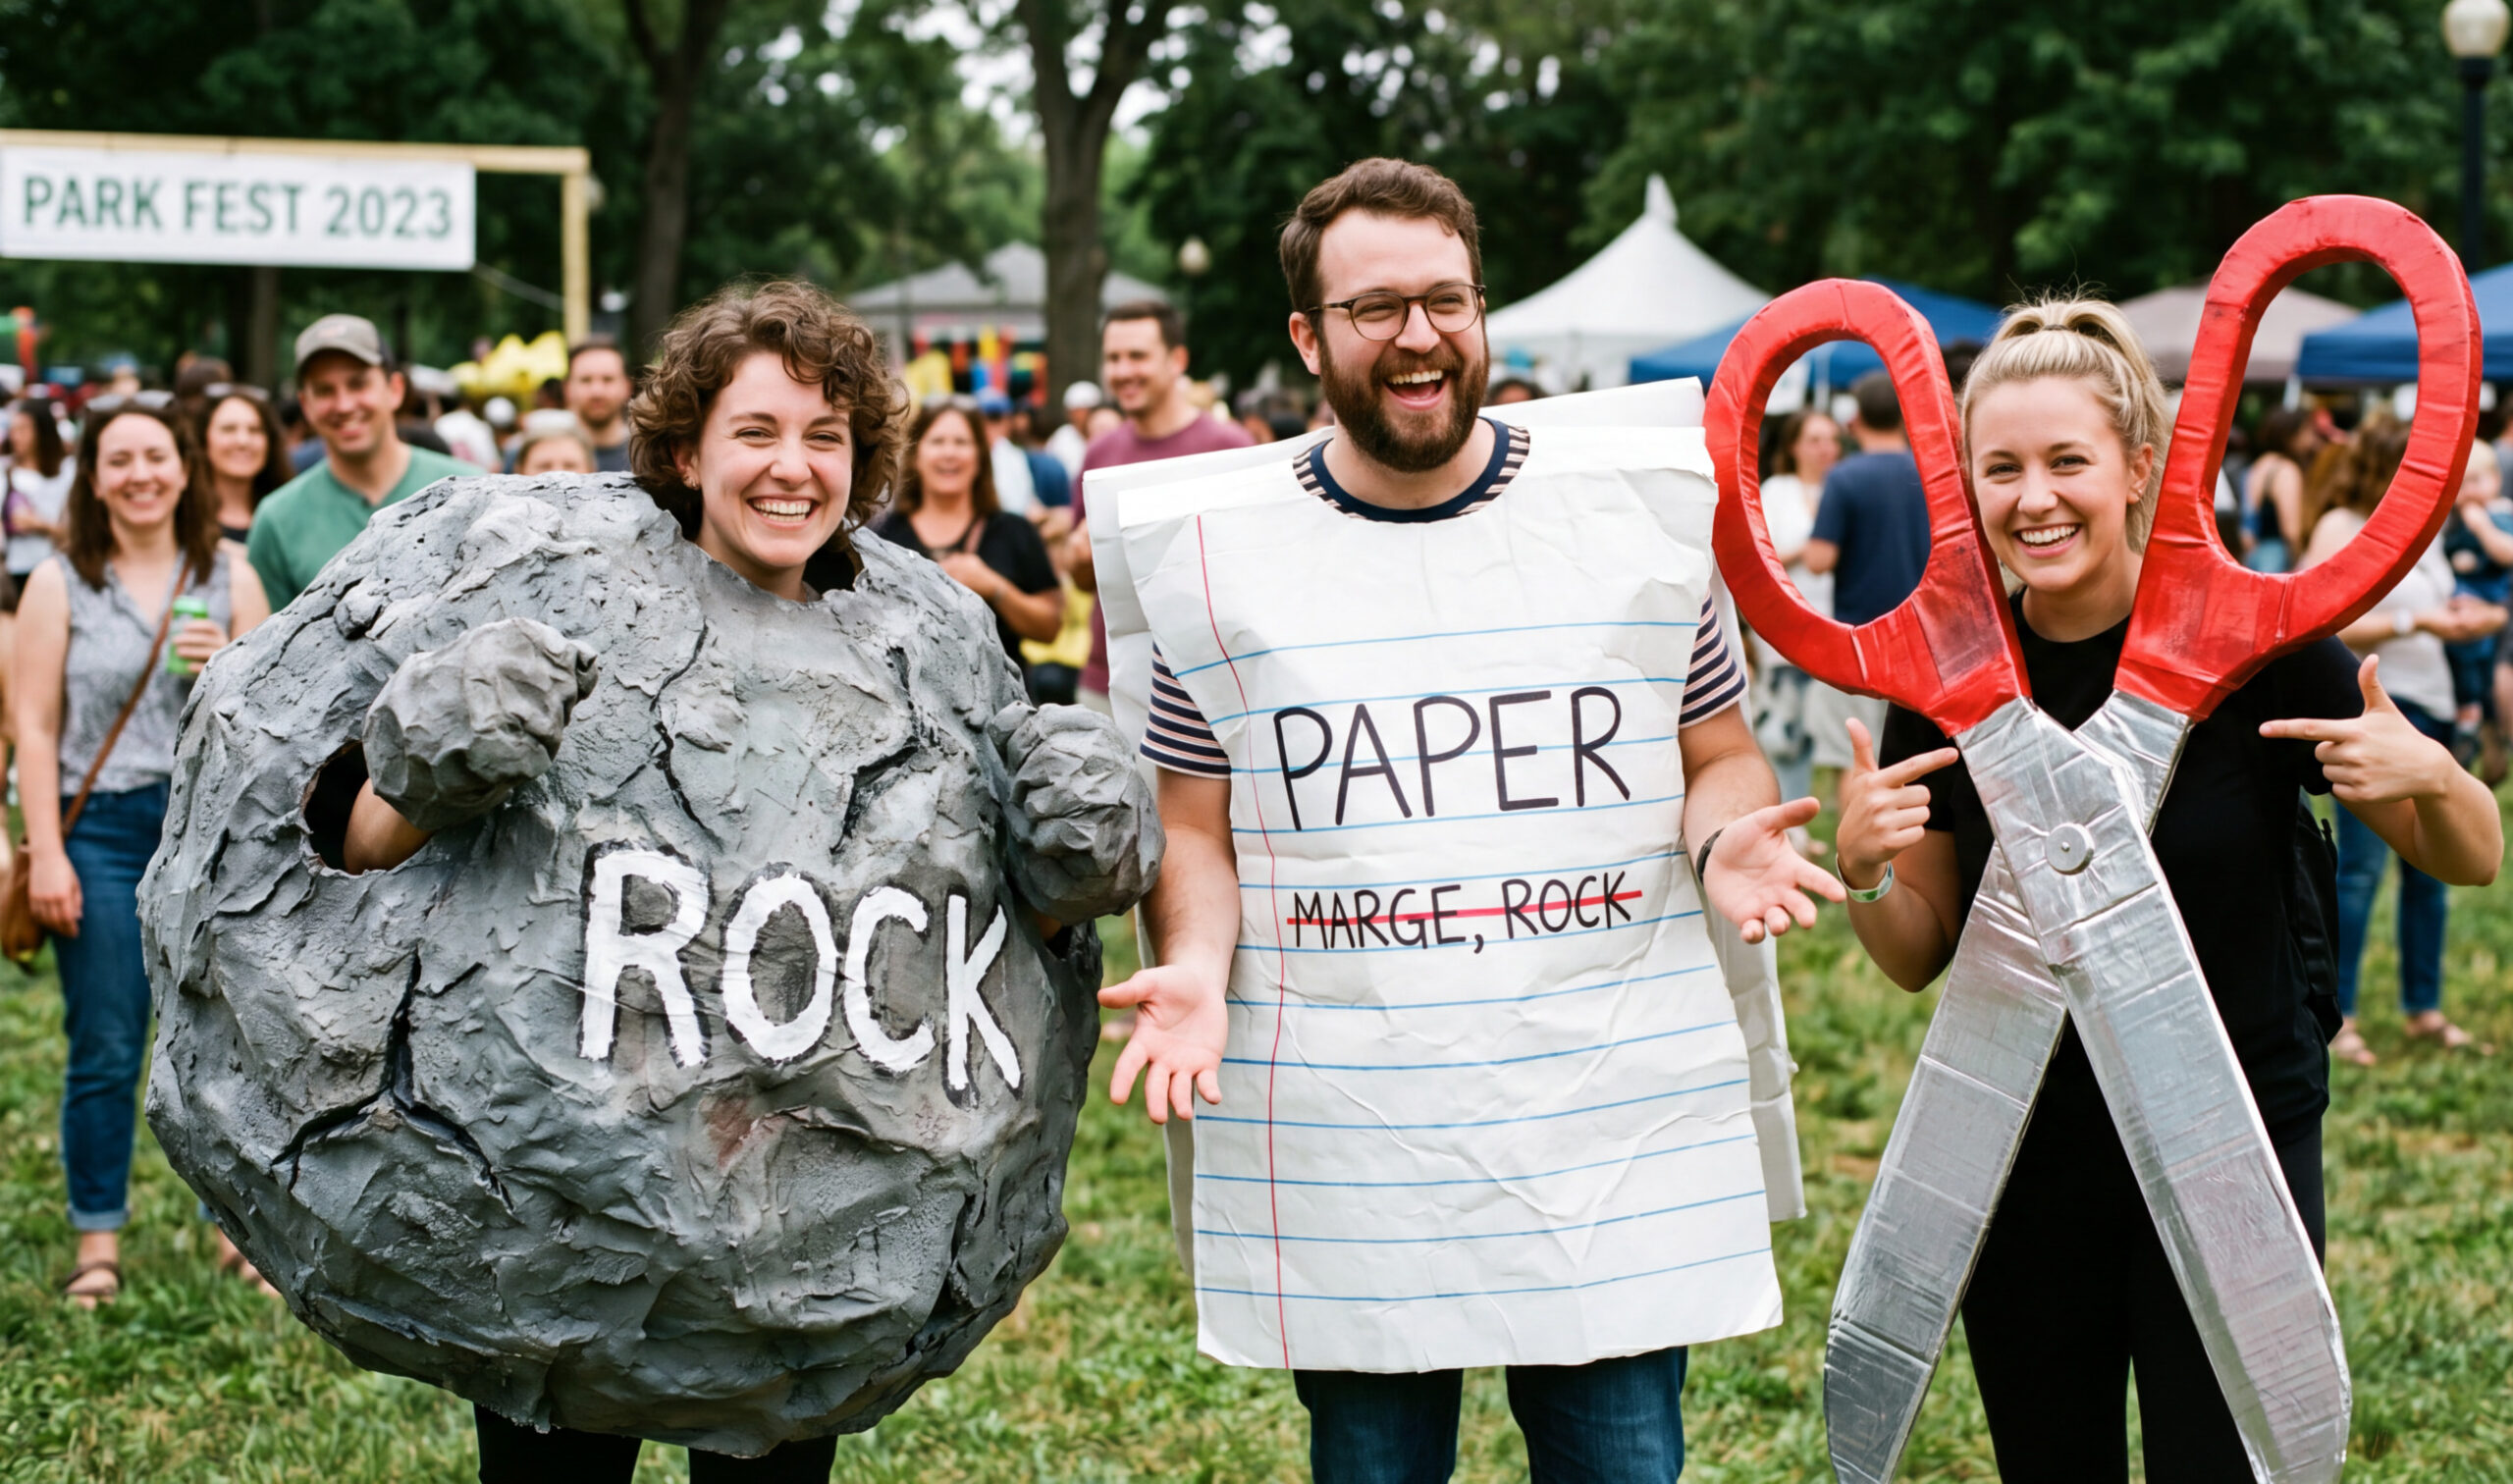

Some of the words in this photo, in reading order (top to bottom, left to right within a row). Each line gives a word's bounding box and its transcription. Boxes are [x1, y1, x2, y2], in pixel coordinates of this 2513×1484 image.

[23, 173, 164, 232] PARK
[183, 181, 304, 236] FEST
[325, 186, 453, 239] 2023
[1272, 685, 1631, 832] PAPER
[578, 839, 1023, 1097] ROCK
[1293, 883, 1485, 954] MARGE,
[1501, 870, 1631, 940] ROCK
